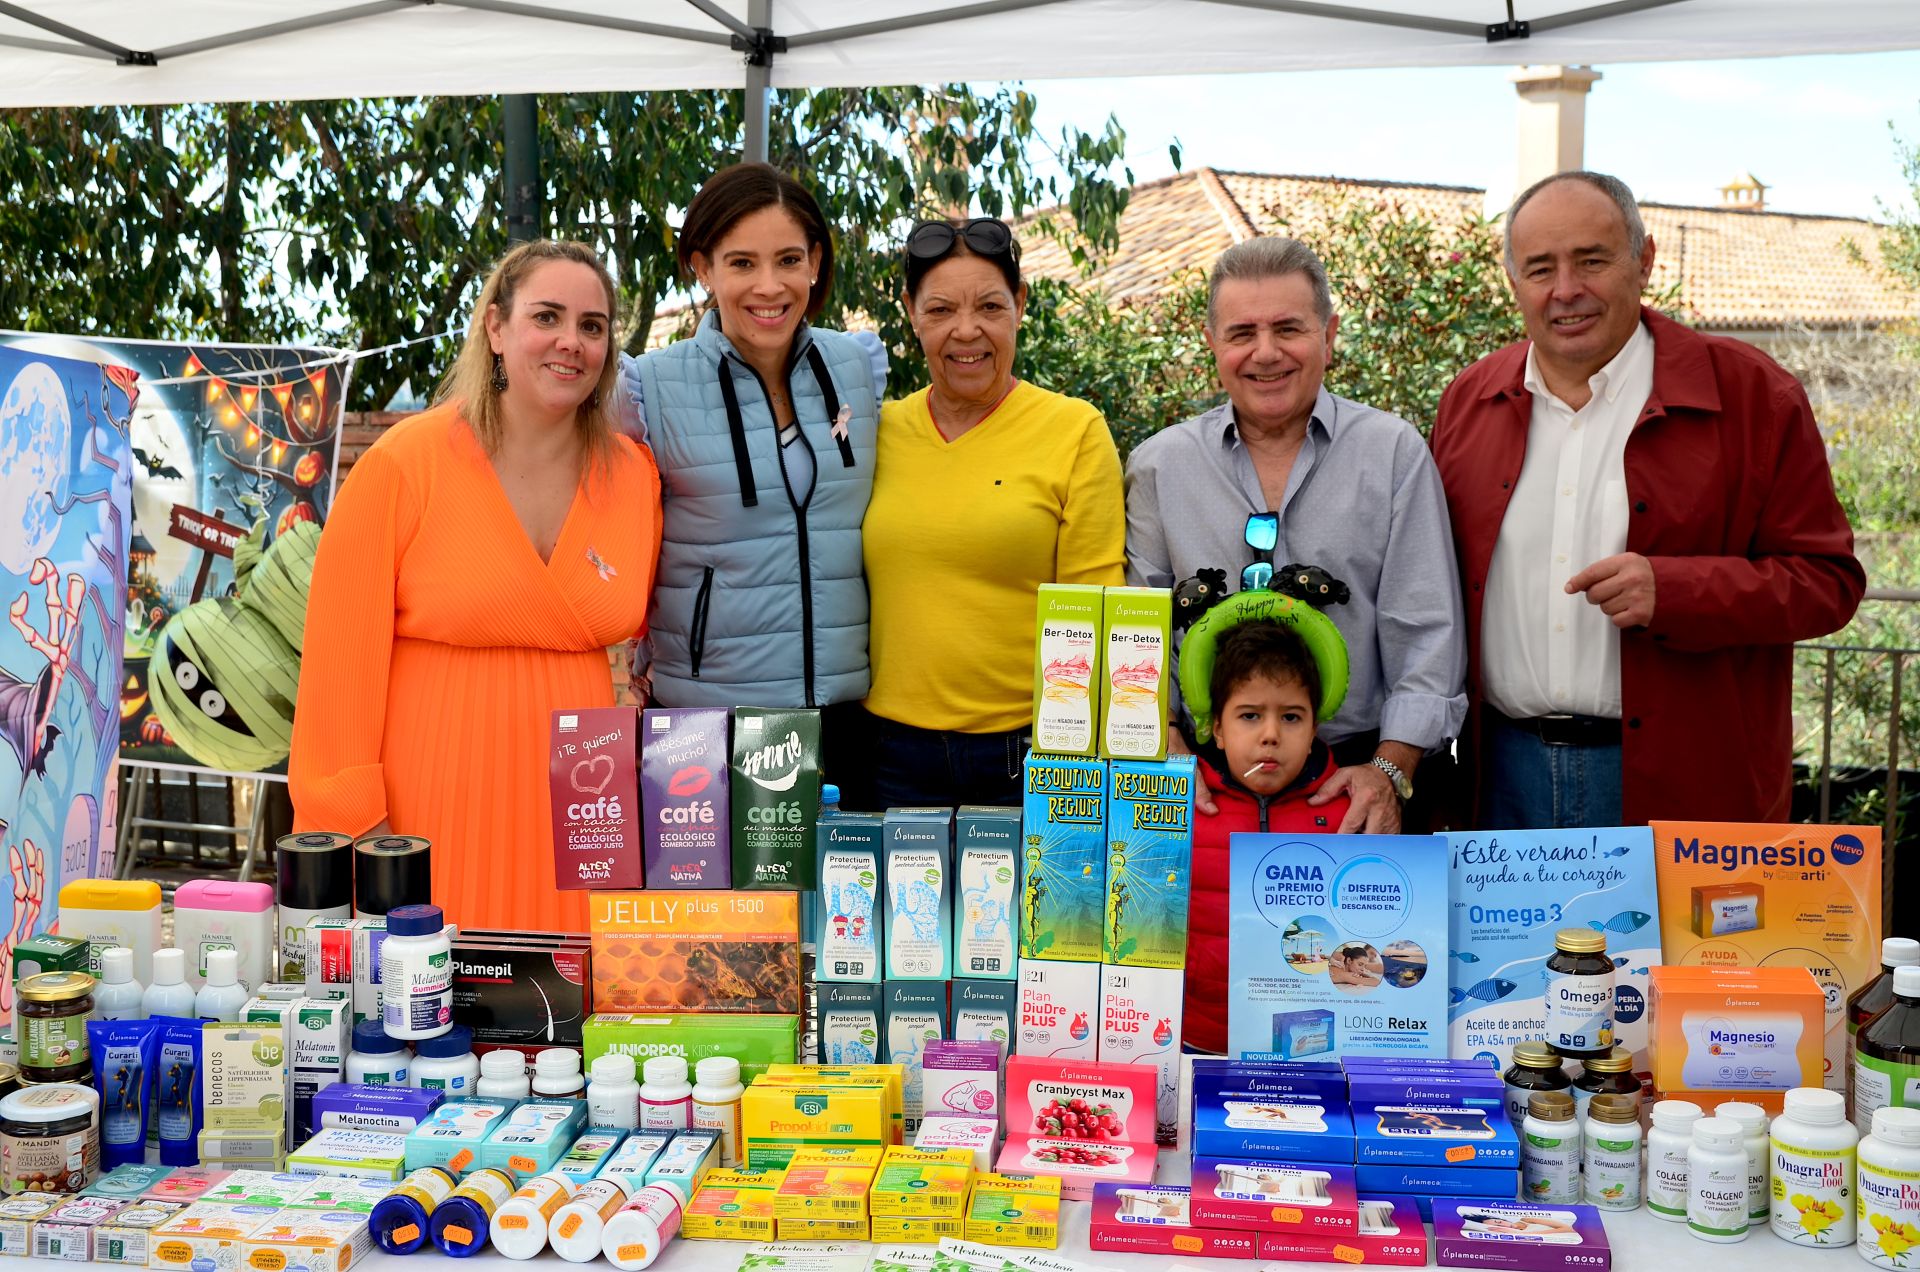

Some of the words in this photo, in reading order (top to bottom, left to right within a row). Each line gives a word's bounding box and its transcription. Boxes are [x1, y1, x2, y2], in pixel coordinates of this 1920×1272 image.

[178, 514, 204, 536] TRICK
[204, 527, 219, 542] OR
[220, 532, 238, 548] TRE
[1056, 604, 1092, 612] plameca
[1124, 608, 1159, 616] plameca
[1236, 598, 1275, 616] Happy
[1044, 628, 1093, 639] Ber-Detox
[1112, 634, 1160, 644] Ber-Detox
[557, 742, 578, 758] ¡Te
[582, 729, 623, 755] quiero!
[655, 731, 706, 754] ¡Bésame
[667, 743, 708, 766] mucho!
[1028, 767, 1101, 793] RESOLUTIVO
[1114, 773, 1188, 800] RESOLUTIVO
[568, 796, 622, 820] café
[660, 801, 715, 824] café
[748, 801, 802, 824] café
[1048, 797, 1102, 822] REGIUM
[584, 818, 627, 826] cacao
[1133, 804, 1188, 830] REGIUM
[762, 825, 807, 833] mundo
[568, 832, 623, 844] ECOLÓGICO
[660, 831, 716, 842] ECOLÓGICO
[747, 831, 802, 842] ECOLÓGICO
[838, 834, 870, 842] plameca
[902, 832, 935, 840] plameca
[1453, 838, 1511, 868] ¡Este
[1516, 836, 1598, 862] verano!
[1833, 842, 1863, 856] NUEVO
[830, 856, 870, 864] Protectium
[894, 854, 935, 862] Protectium
[968, 852, 1008, 860] Protectium
[1674, 838, 1826, 872] Magnesio
[578, 862, 611, 872] ALTER
[670, 863, 702, 872] ALTER
[755, 864, 788, 874] ALTER
[1266, 864, 1324, 880] GANA
[578, 870, 610, 880] NATIVA
[670, 872, 702, 881] NATIVA
[756, 872, 788, 882] NATIVA
[1466, 864, 1519, 892] ayuda
[1523, 872, 1534, 882] a
[1538, 865, 1558, 882] tu
[1562, 866, 1626, 889] corazón
[1763, 870, 1774, 880] by
[1776, 870, 1826, 881] Curarti
[1278, 883, 1324, 892] PREMIO
[1348, 884, 1400, 893] DISFRUTA
[600, 900, 678, 924] JELLY
[686, 901, 718, 916] plus
[729, 899, 764, 914] 1500
[1722, 904, 1748, 912] Magnesio
[1470, 905, 1546, 926] Omega
[1550, 904, 1562, 922] 3
[1701, 950, 1738, 960] AYUDA
[436, 958, 446, 968] ESI
[452, 962, 512, 978] Plamepil
[412, 983, 446, 993] Gummies
[838, 994, 870, 1002] plameca
[902, 994, 935, 1002] plameca
[972, 992, 1004, 1000] plameca
[1024, 989, 1050, 1002] Plan
[1106, 994, 1134, 1007] Plan
[1560, 988, 1606, 1004] Omega
[1022, 1002, 1066, 1015] DiuDre
[1624, 1003, 1638, 1012] DÍA
[830, 1015, 870, 1023] Protectium
[963, 1013, 1003, 1022] Protectium
[1106, 1008, 1150, 1020] DiuDre
[308, 1020, 322, 1028] ESI
[895, 1016, 935, 1024] Protectium
[1022, 1015, 1056, 1027] PLUS
[1344, 1016, 1382, 1028] LONG
[1388, 1017, 1427, 1030] Relax
[1466, 1019, 1496, 1030] Aceite
[1498, 1018, 1509, 1030] de
[1105, 1020, 1140, 1032] PLUS
[30, 1020, 38, 1057] AVELLANAS
[1467, 1035, 1484, 1046] EPA
[1487, 1034, 1504, 1046] 454
[1711, 1031, 1774, 1044] Magnesio
[260, 1041, 278, 1060] be
[294, 1040, 336, 1052] Melatonin
[604, 1044, 688, 1057] JUNIORPOL
[692, 1044, 714, 1057] KIDS
[108, 1050, 138, 1060] Curarti
[164, 1048, 190, 1057] Curarti
[294, 1052, 312, 1062] Pura
[1247, 1053, 1284, 1061] NOVEDAD
[208, 1052, 222, 1105] benecos
[1068, 1072, 1102, 1081] plameca
[1036, 1084, 1100, 1098] Cranbycyst
[1102, 1088, 1125, 1100] Max
[804, 1104, 818, 1114] ESI
[339, 1114, 400, 1127] Melanoctina
[770, 1121, 828, 1134] Propolaid
[1036, 1140, 1096, 1150] Cranbycyst
[796, 1154, 873, 1164] Propolaid
[888, 1152, 966, 1163] Propolaid
[1594, 1159, 1636, 1168] ASHWAGANDHA
[1778, 1154, 1843, 1179] OnagraPol
[1246, 1166, 1302, 1175] Triptófano
[977, 1179, 1056, 1190] Propolaid
[1821, 1178, 1842, 1188] 1000
[1700, 1189, 1744, 1200] COLÁGENO
[1480, 1208, 1552, 1216] Melanoctina
[1104, 1236, 1136, 1244] plameca
[1271, 1244, 1304, 1252] plameca
[1450, 1252, 1484, 1260] plameca
